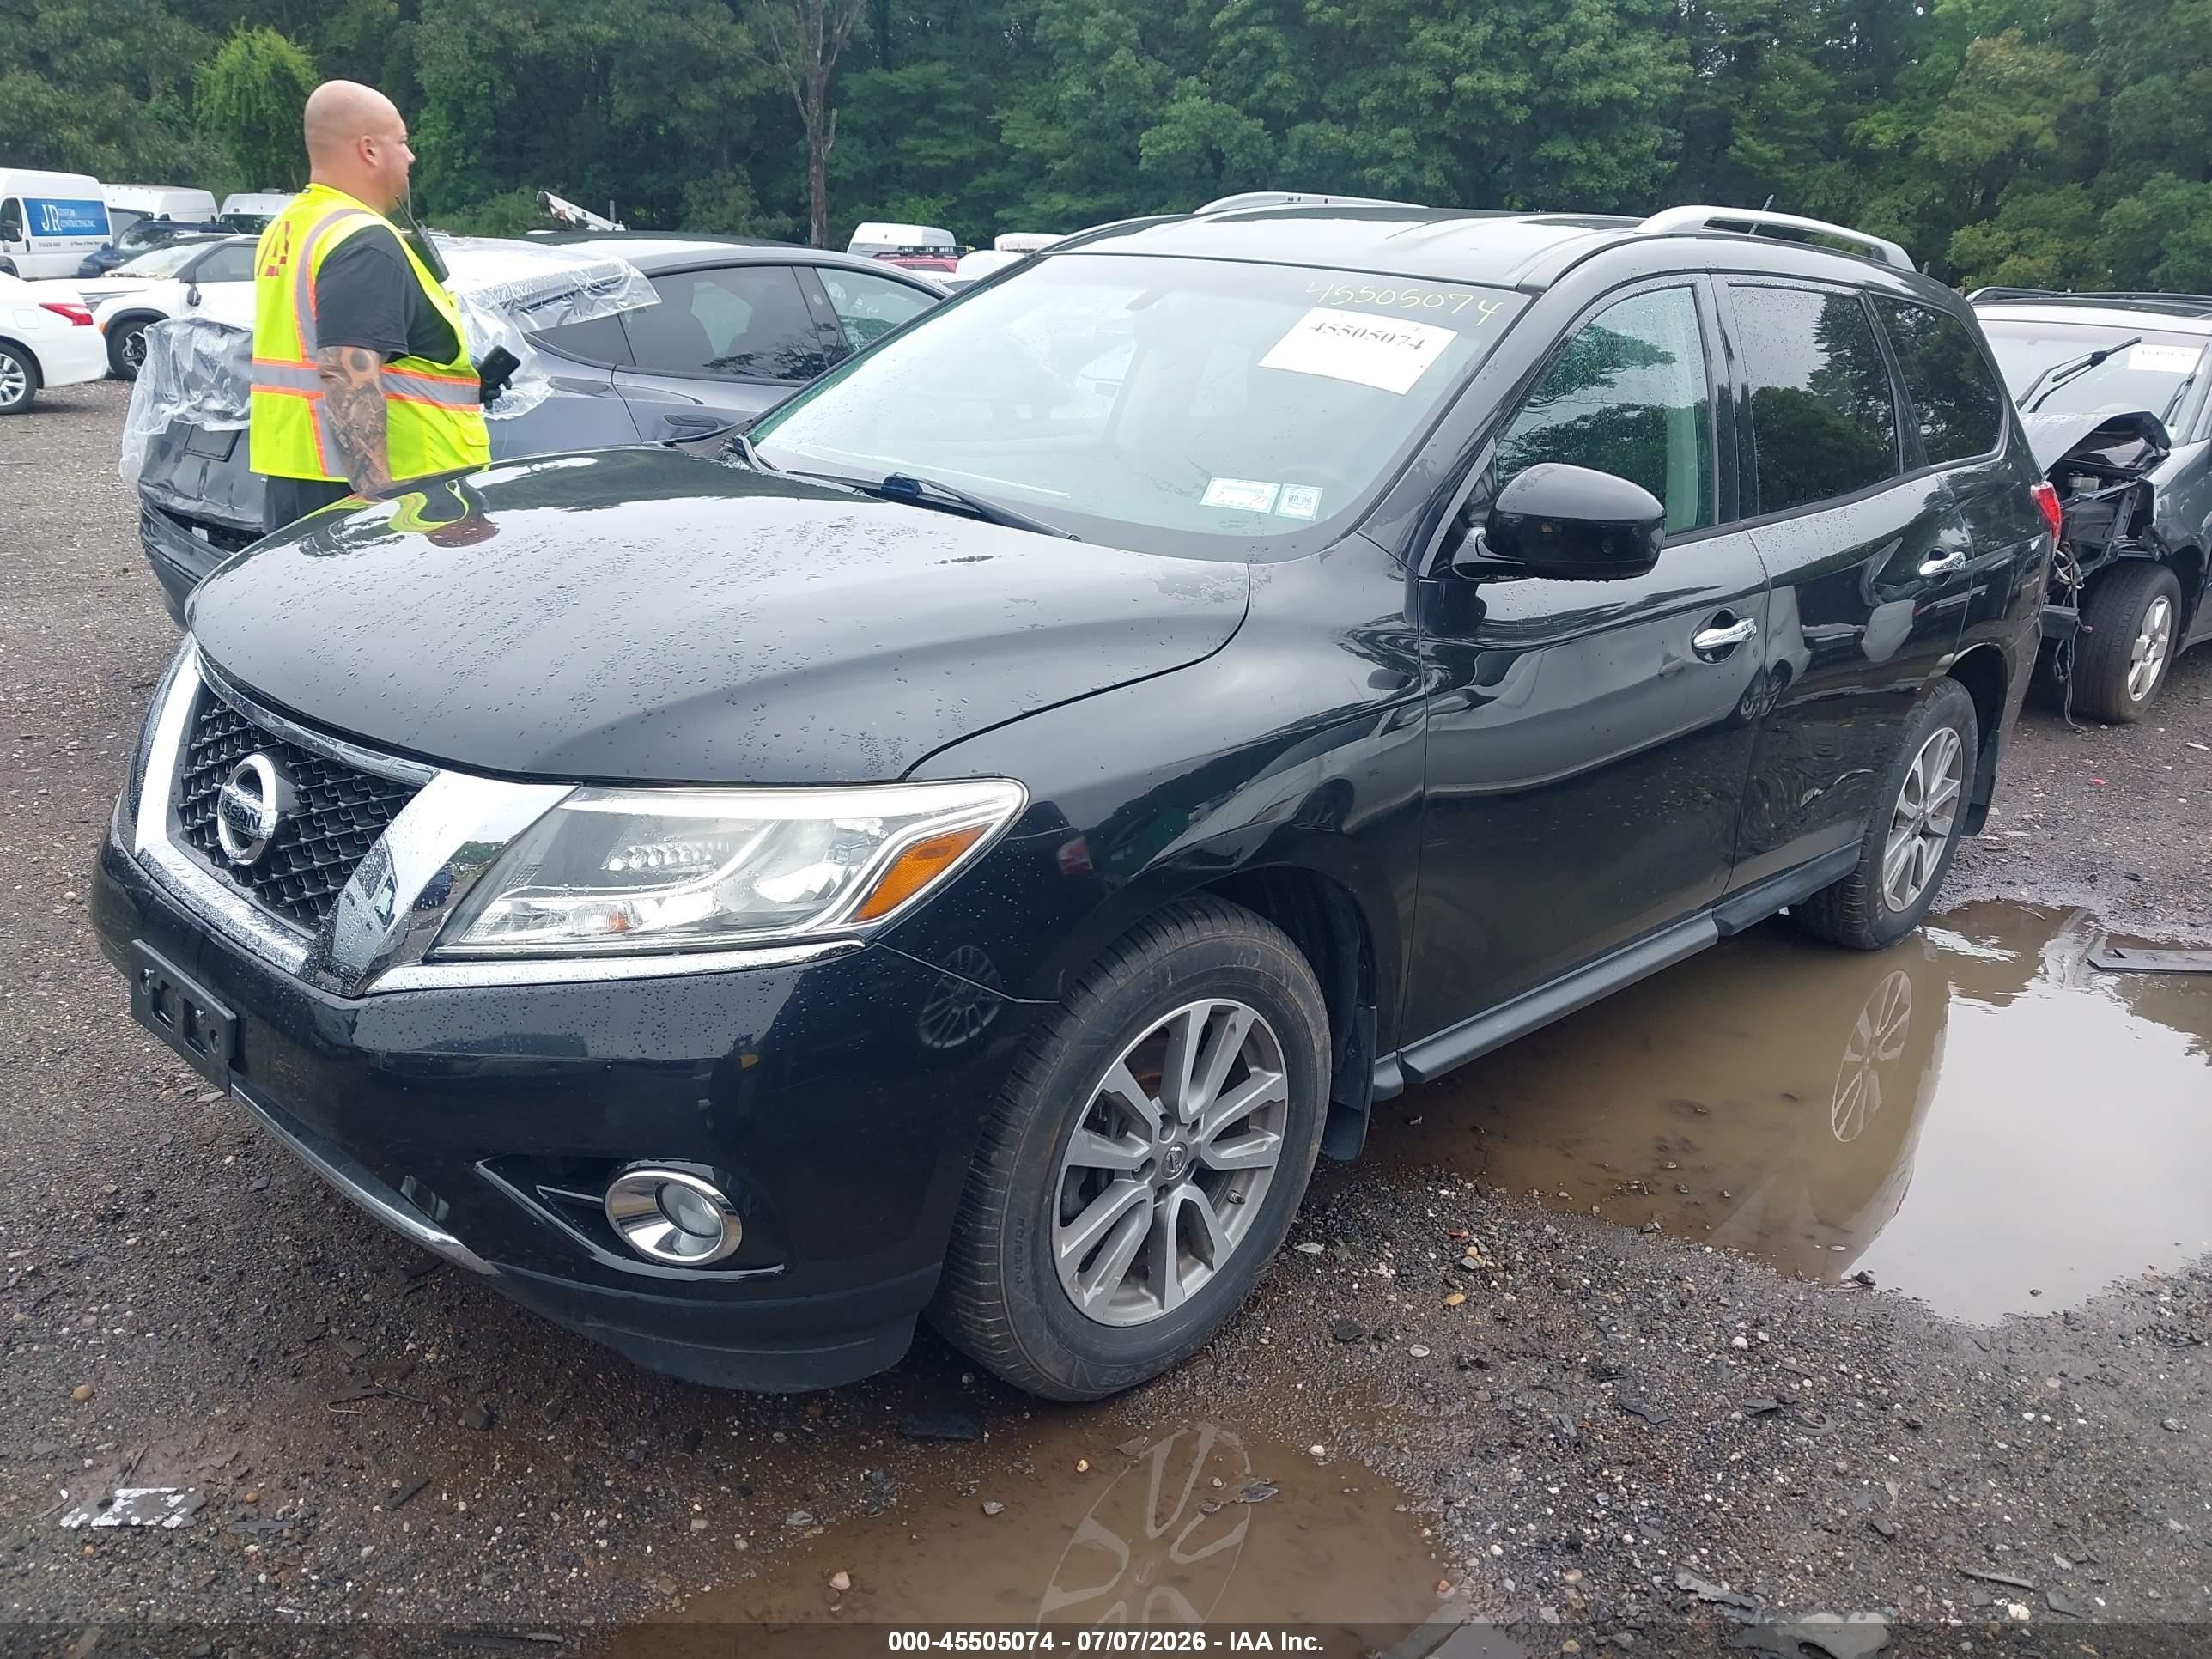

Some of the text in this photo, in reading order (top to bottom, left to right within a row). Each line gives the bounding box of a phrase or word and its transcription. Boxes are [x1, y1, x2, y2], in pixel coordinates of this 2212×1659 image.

[40, 204, 62, 232] JR
[1306, 282, 1503, 326] 45505074
[1310, 322, 1425, 350] 45505074
